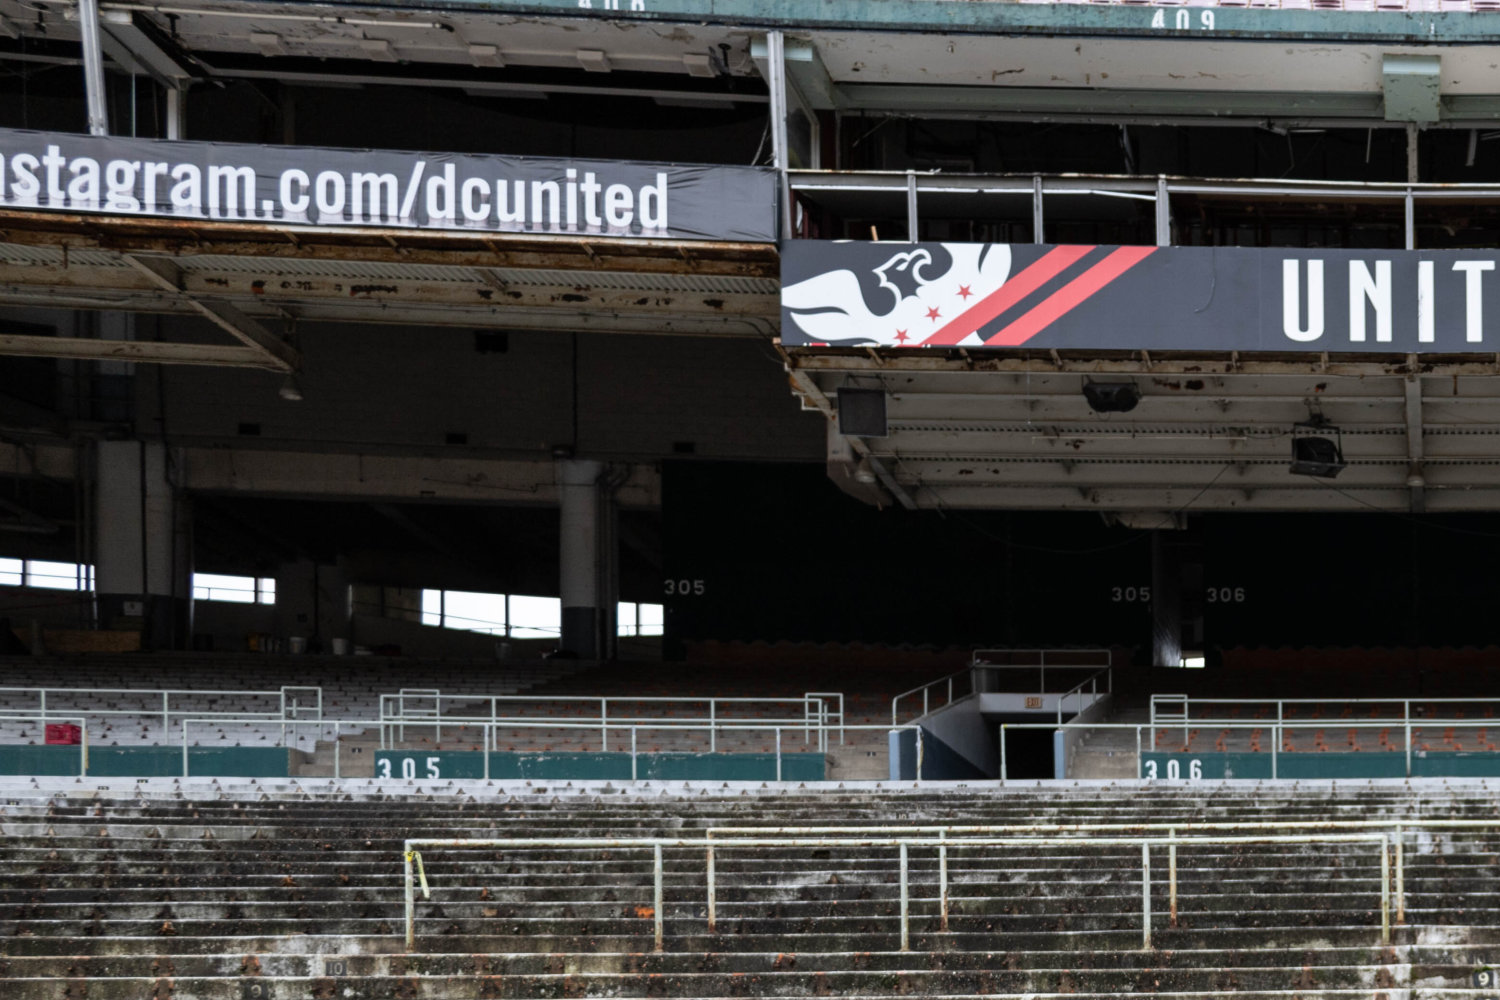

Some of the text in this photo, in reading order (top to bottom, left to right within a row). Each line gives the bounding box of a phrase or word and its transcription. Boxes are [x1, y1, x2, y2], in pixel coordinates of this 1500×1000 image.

[1151, 8, 1215, 30] 409
[663, 579, 706, 596] 305
[1111, 586, 1150, 603] 305
[1206, 587, 1246, 603] 306
[377, 756, 440, 780] 305
[1145, 759, 1203, 780] 306
[329, 962, 343, 975] 10
[1478, 972, 1490, 986] 9
[252, 984, 262, 998] 9
